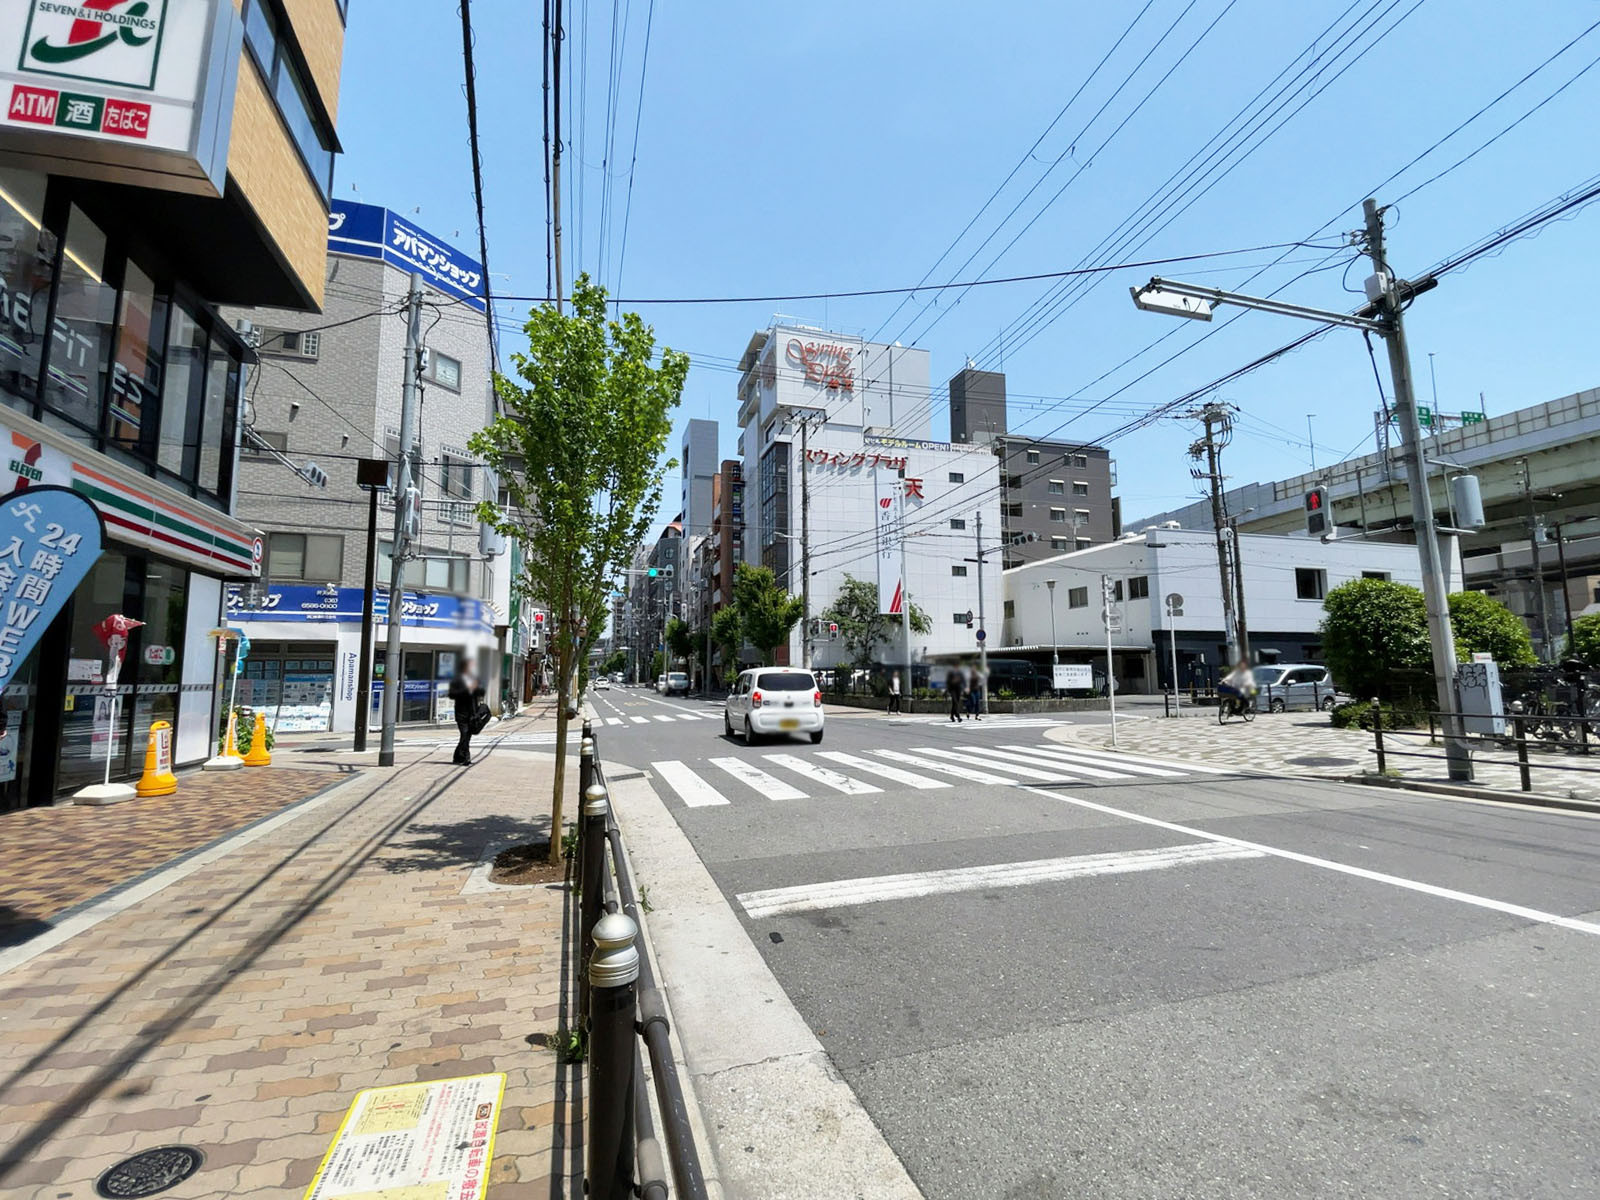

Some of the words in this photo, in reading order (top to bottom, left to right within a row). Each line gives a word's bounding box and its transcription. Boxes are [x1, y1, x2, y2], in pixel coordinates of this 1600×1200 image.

[94, 11, 156, 30] HOLDINGS
[11, 92, 55, 118] ATM
[65, 99, 95, 124] 酒
[105, 106, 148, 132] たばこ
[392, 227, 481, 288] アパマンショップ
[904, 478, 925, 499] 天
[347, 652, 355, 702] Apamanshop
